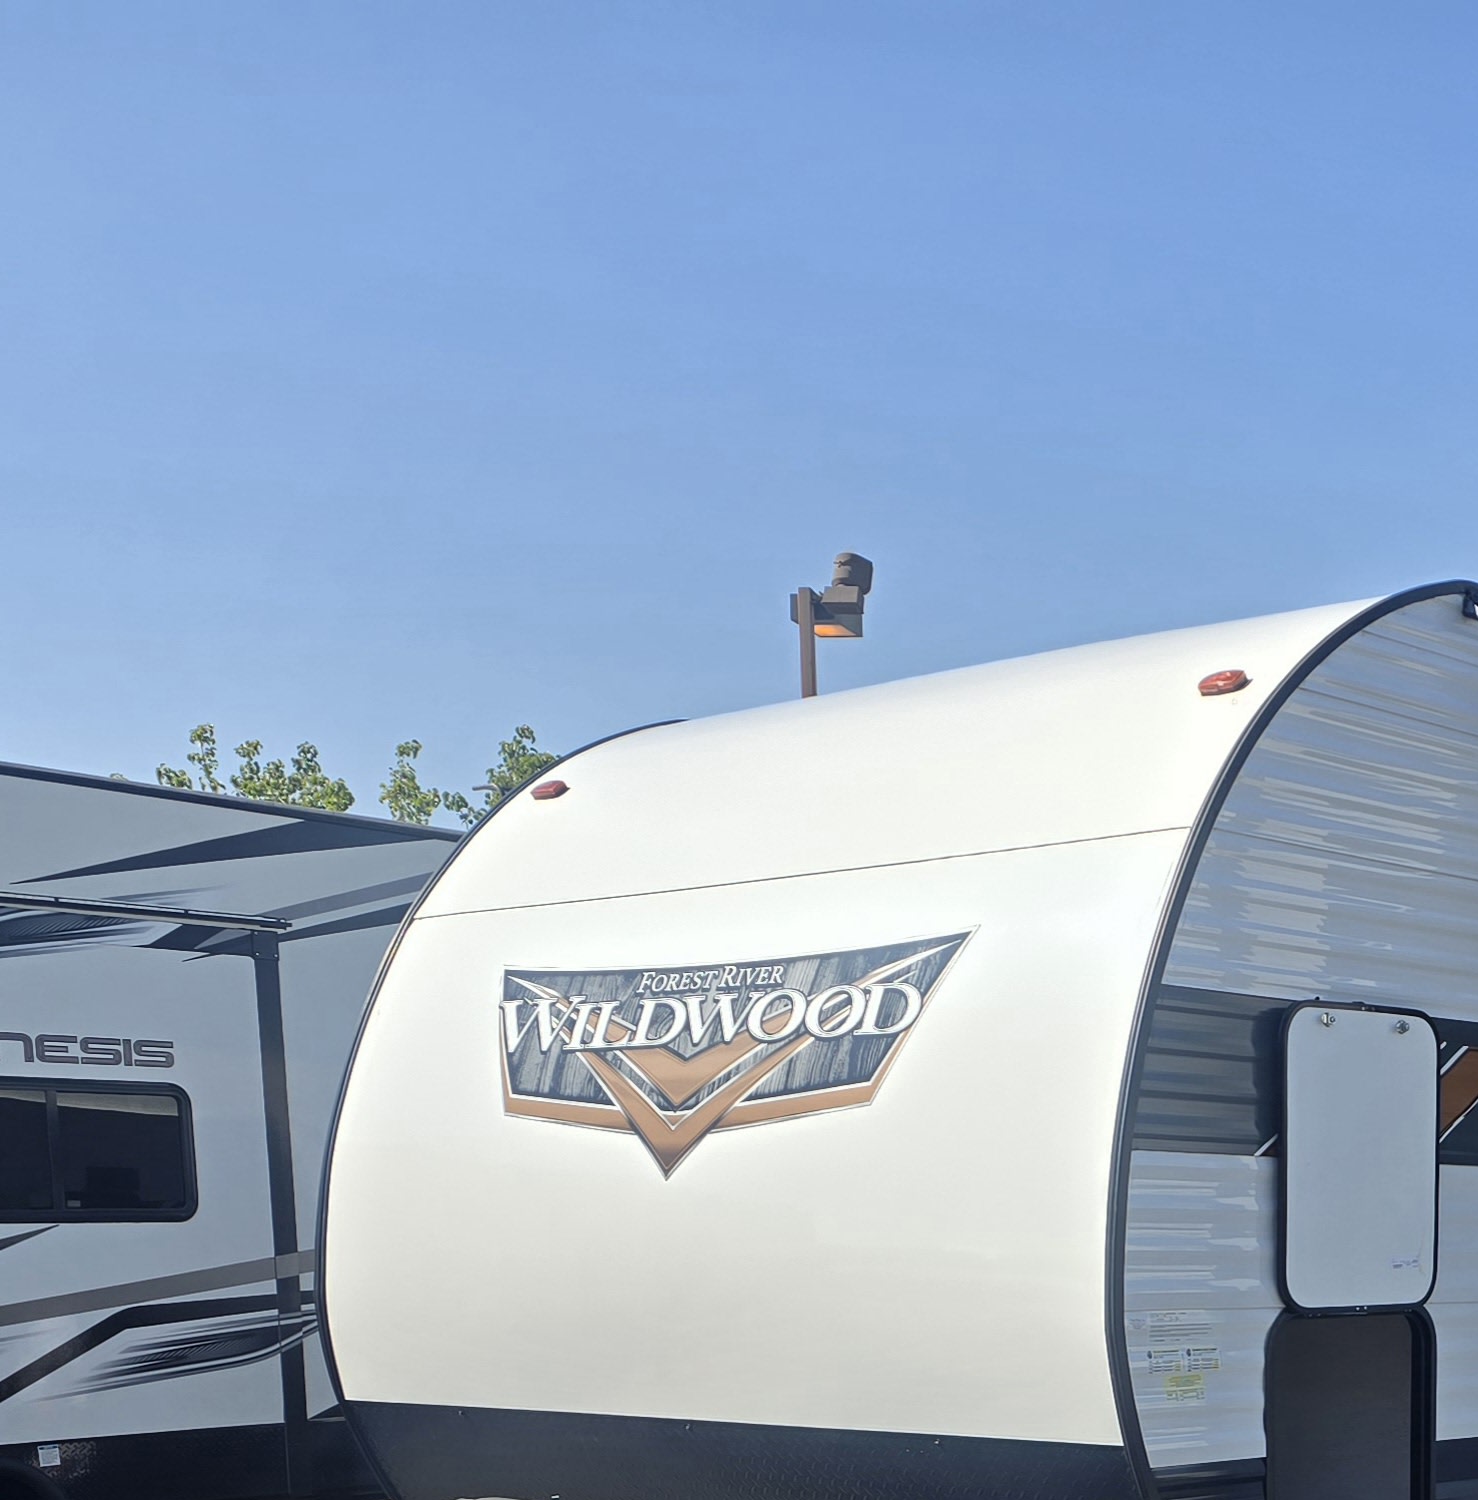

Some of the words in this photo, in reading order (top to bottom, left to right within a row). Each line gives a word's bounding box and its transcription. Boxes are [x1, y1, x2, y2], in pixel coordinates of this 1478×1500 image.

[636, 970, 719, 993] FOREST
[718, 965, 784, 988] RIVER
[499, 982, 922, 1054] WILDWOOD
